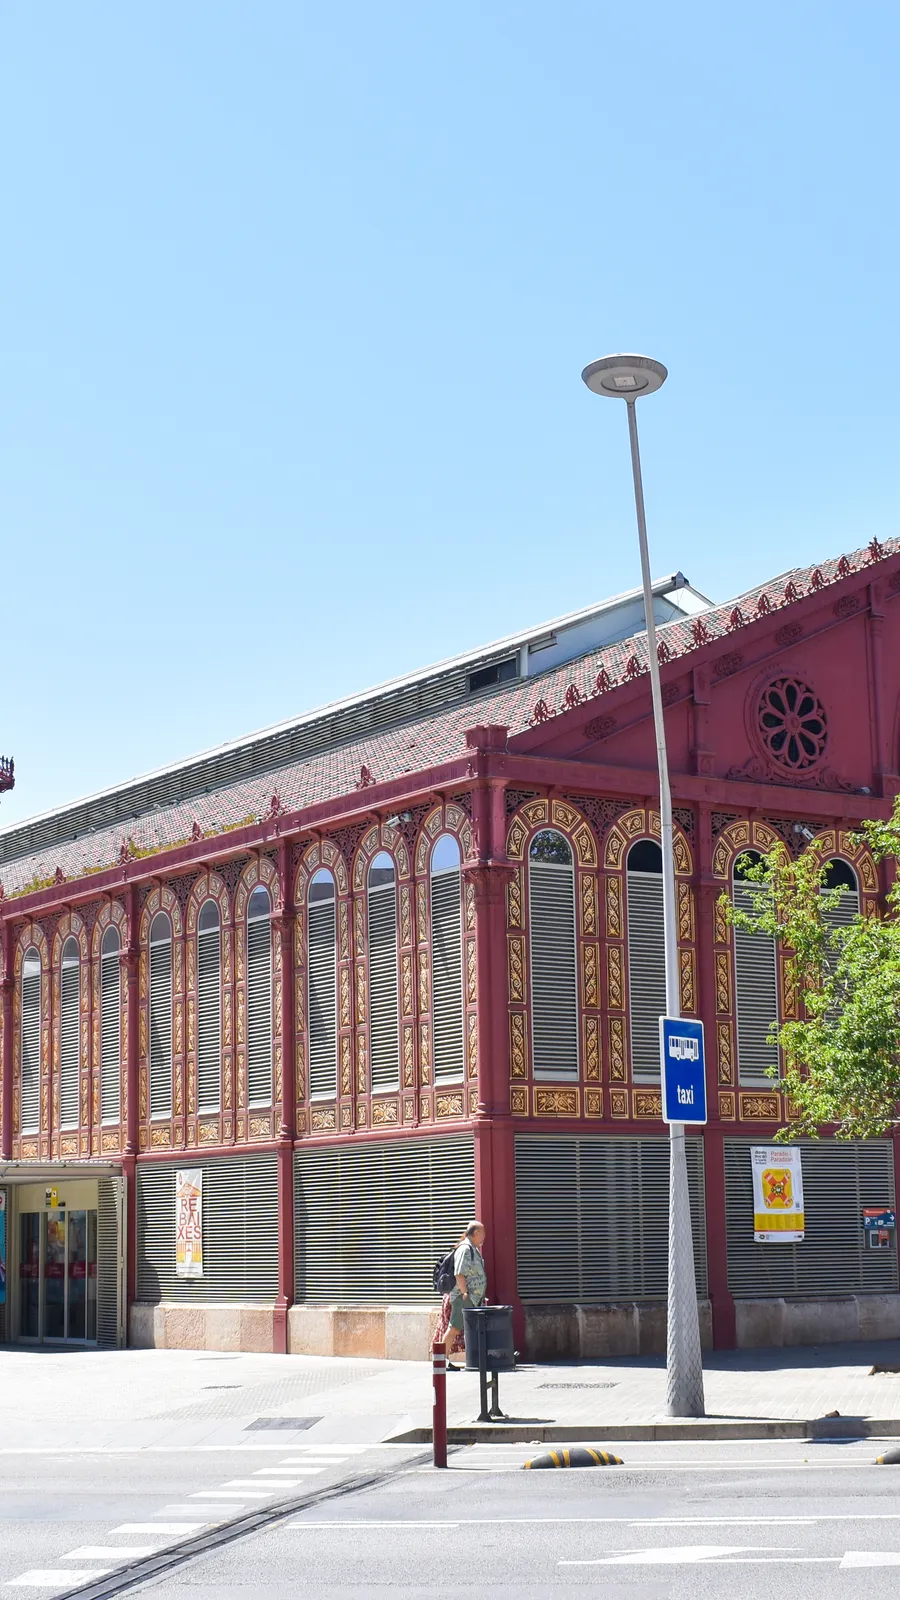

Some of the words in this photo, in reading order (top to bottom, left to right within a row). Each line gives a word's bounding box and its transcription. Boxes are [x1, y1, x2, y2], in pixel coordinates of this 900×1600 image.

[677, 1084, 694, 1104] taxi
[181, 1198, 198, 1212] RE
[180, 1212, 200, 1226] BAI
[177, 1226, 202, 1239] XES
